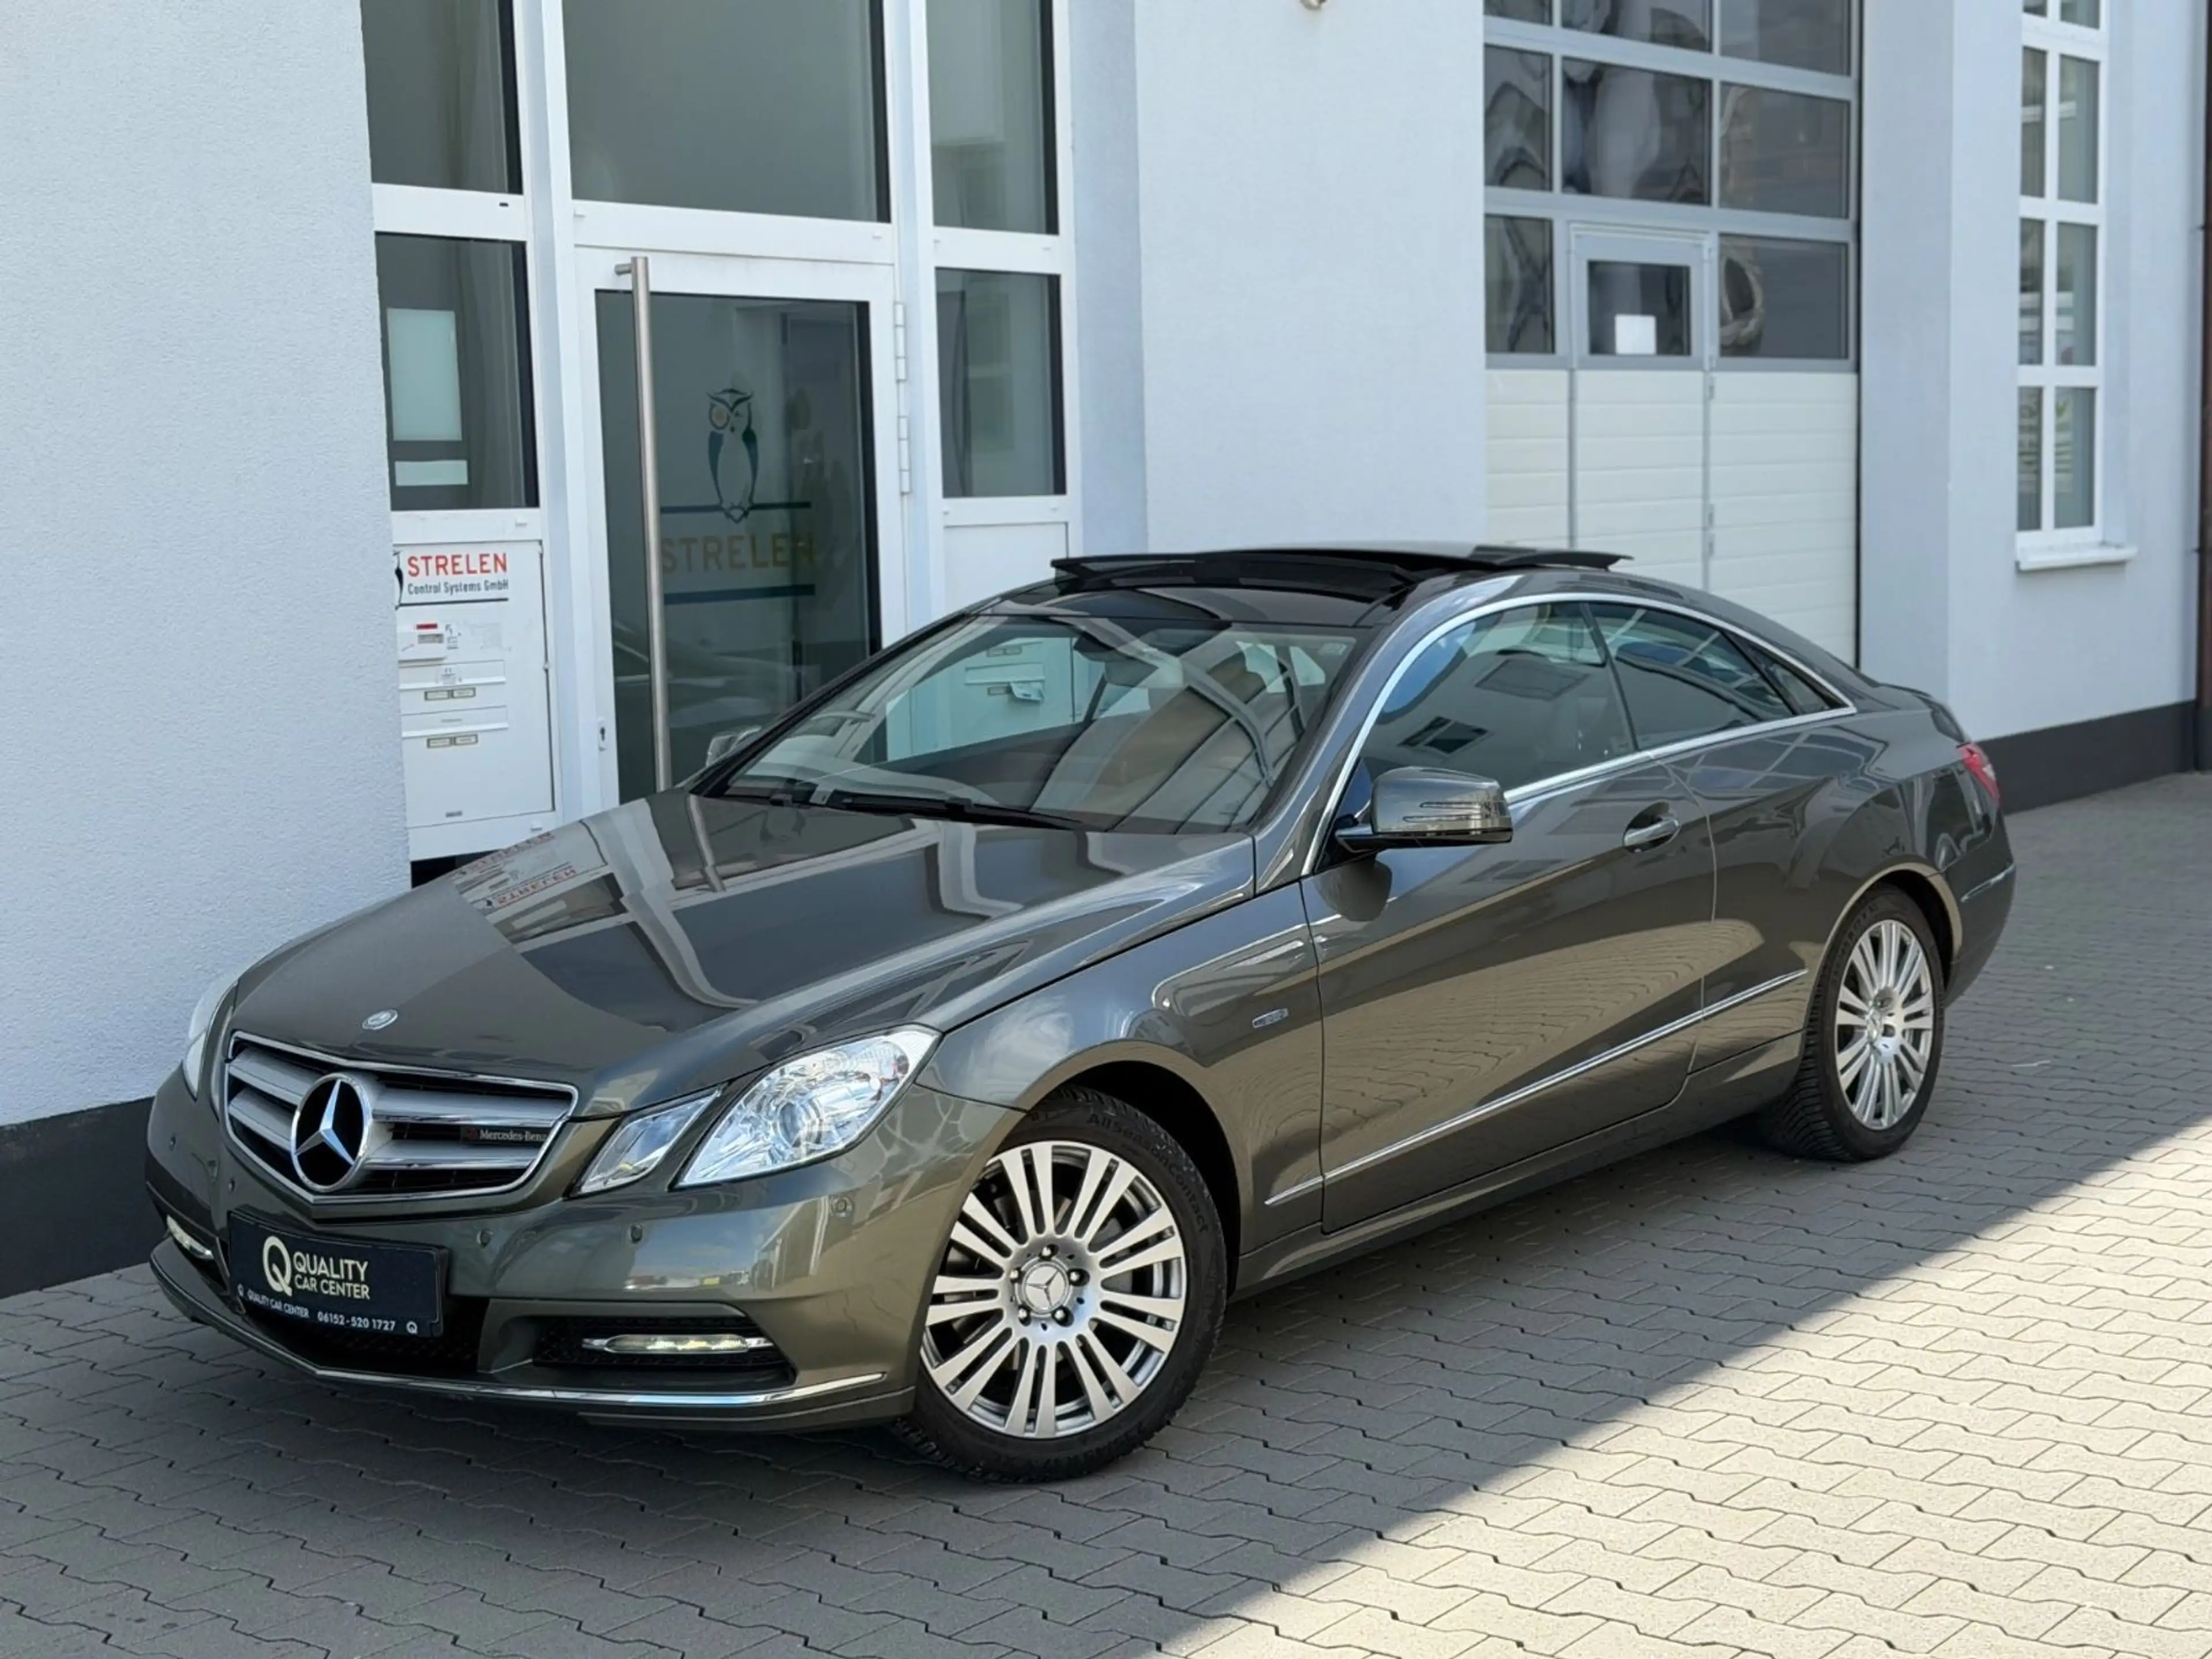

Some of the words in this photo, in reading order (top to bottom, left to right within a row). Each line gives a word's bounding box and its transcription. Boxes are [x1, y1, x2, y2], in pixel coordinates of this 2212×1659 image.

[407, 552, 507, 577] STRELEN
[407, 581, 441, 595] Control
[444, 581, 482, 596] Systems
[484, 579, 509, 591] GmbH
[479, 1128, 547, 1142] Mercedes-Benz
[293, 1251, 369, 1282] QUALITY
[294, 1274, 318, 1293] CAR
[320, 1278, 370, 1300] CENTER
[247, 1288, 270, 1306] QUALITY
[270, 1298, 283, 1312] CAR
[283, 1302, 309, 1319] CENTER
[372, 1318, 396, 1331] 1727
